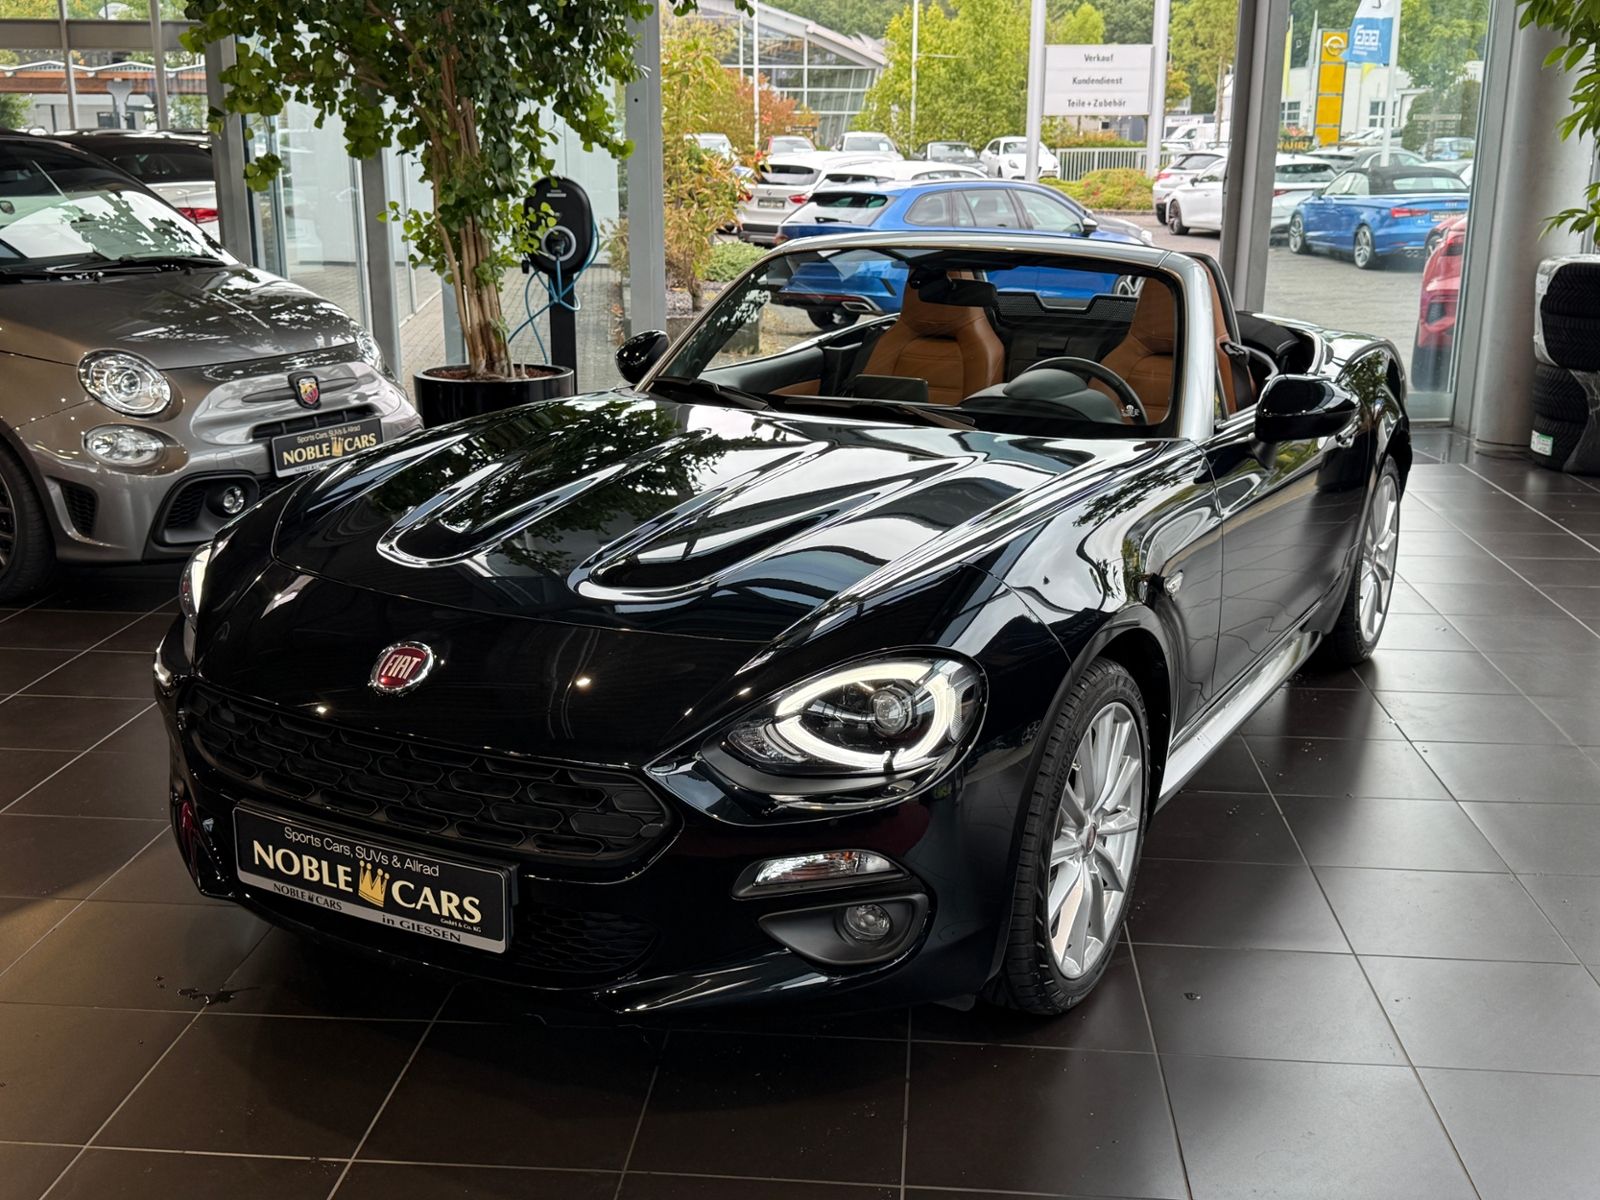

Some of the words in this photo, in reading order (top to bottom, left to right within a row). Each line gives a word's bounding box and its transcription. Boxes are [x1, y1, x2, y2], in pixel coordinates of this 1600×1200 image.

[1083, 53, 1114, 62] Verkauf
[1072, 76, 1123, 85] Kundendienst
[282, 442, 330, 466] NOBLE
[344, 433, 377, 452] CARS
[381, 654, 422, 680] FIAT
[284, 826, 321, 848] Sports
[323, 837, 354, 858] Cars,
[355, 845, 389, 865] SUVs
[391, 855, 401, 869] &
[403, 858, 440, 877] Allrad
[253, 839, 354, 893] NOBLE
[391, 880, 482, 924] CARS
[273, 882, 306, 900] NOBLE
[316, 897, 343, 911] CARS
[382, 914, 395, 926] in
[400, 920, 461, 942] GIESSEN
